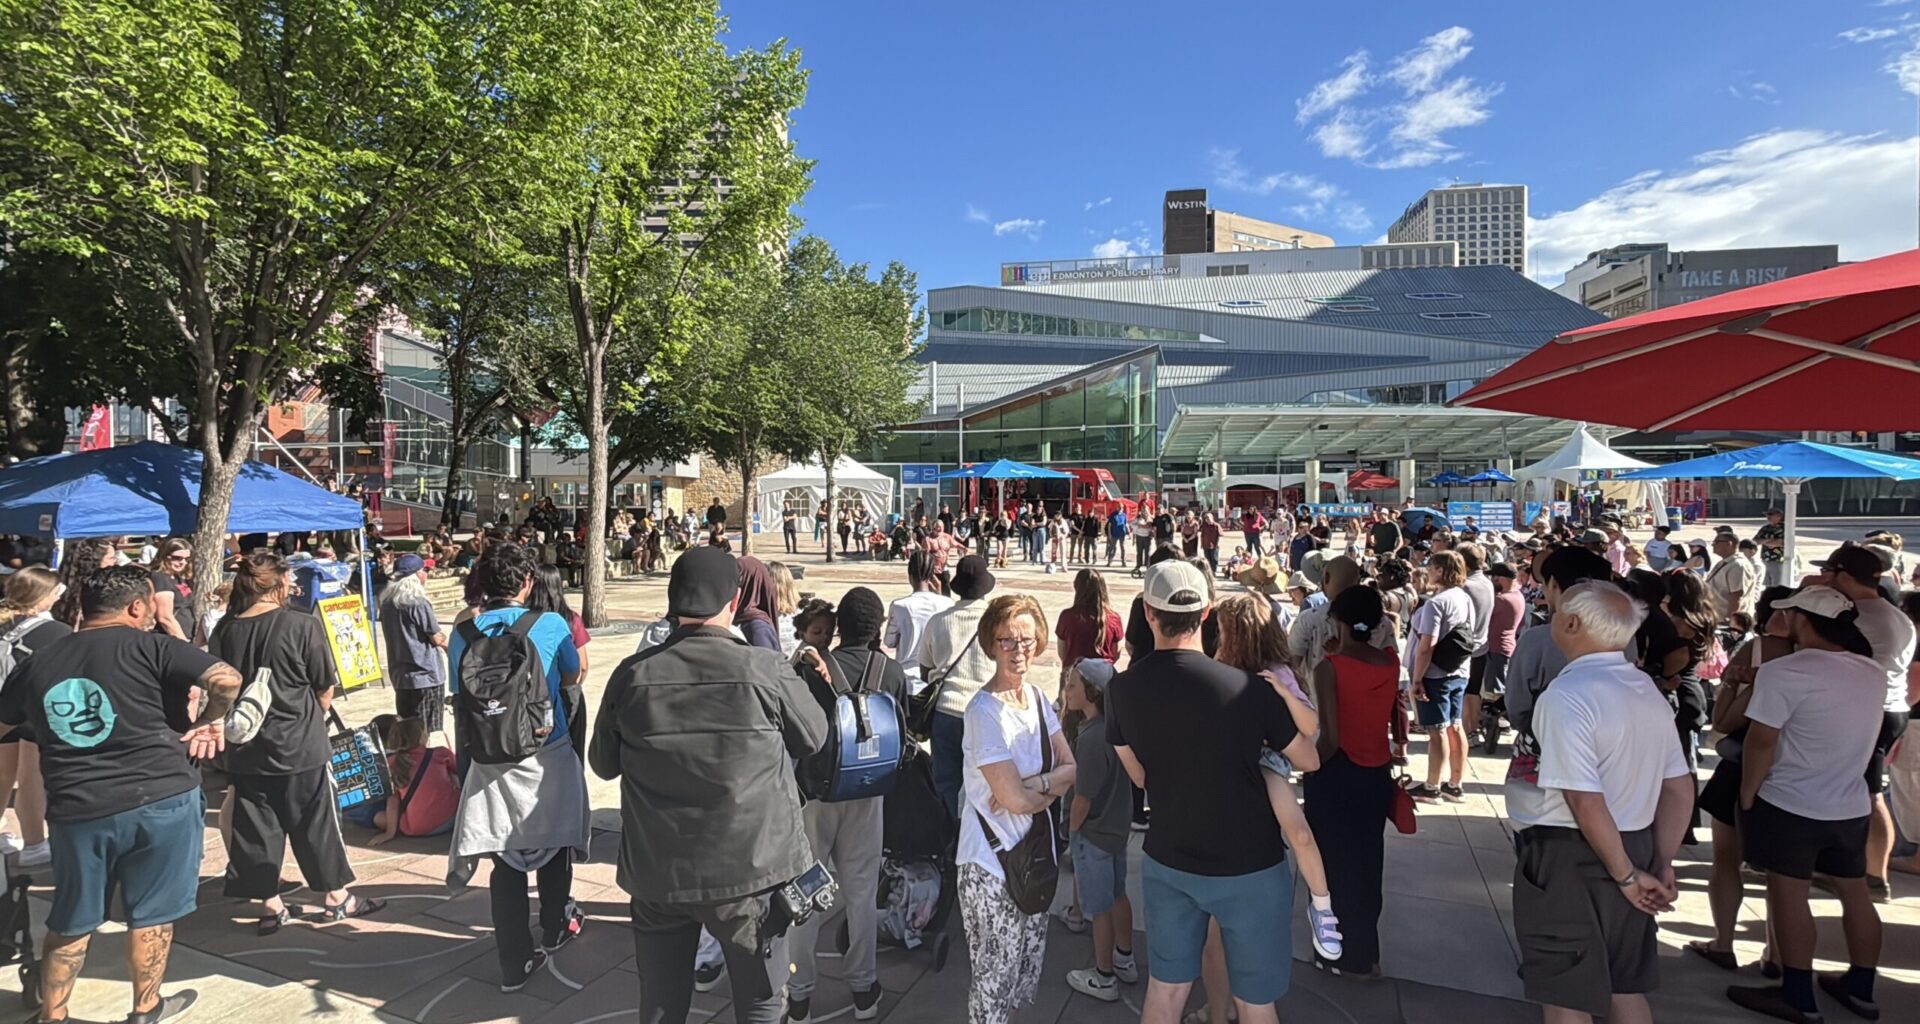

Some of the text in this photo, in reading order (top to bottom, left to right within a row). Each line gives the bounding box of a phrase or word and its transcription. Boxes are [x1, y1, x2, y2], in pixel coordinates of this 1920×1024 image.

[1053, 270, 1104, 280] EDMONTON
[1106, 268, 1138, 278] PUBLIC
[1680, 266, 1788, 288] TAKE A RISK
[332, 751, 351, 763] AD
[334, 765, 362, 780] EPEAT
[338, 773, 366, 790] EAD
